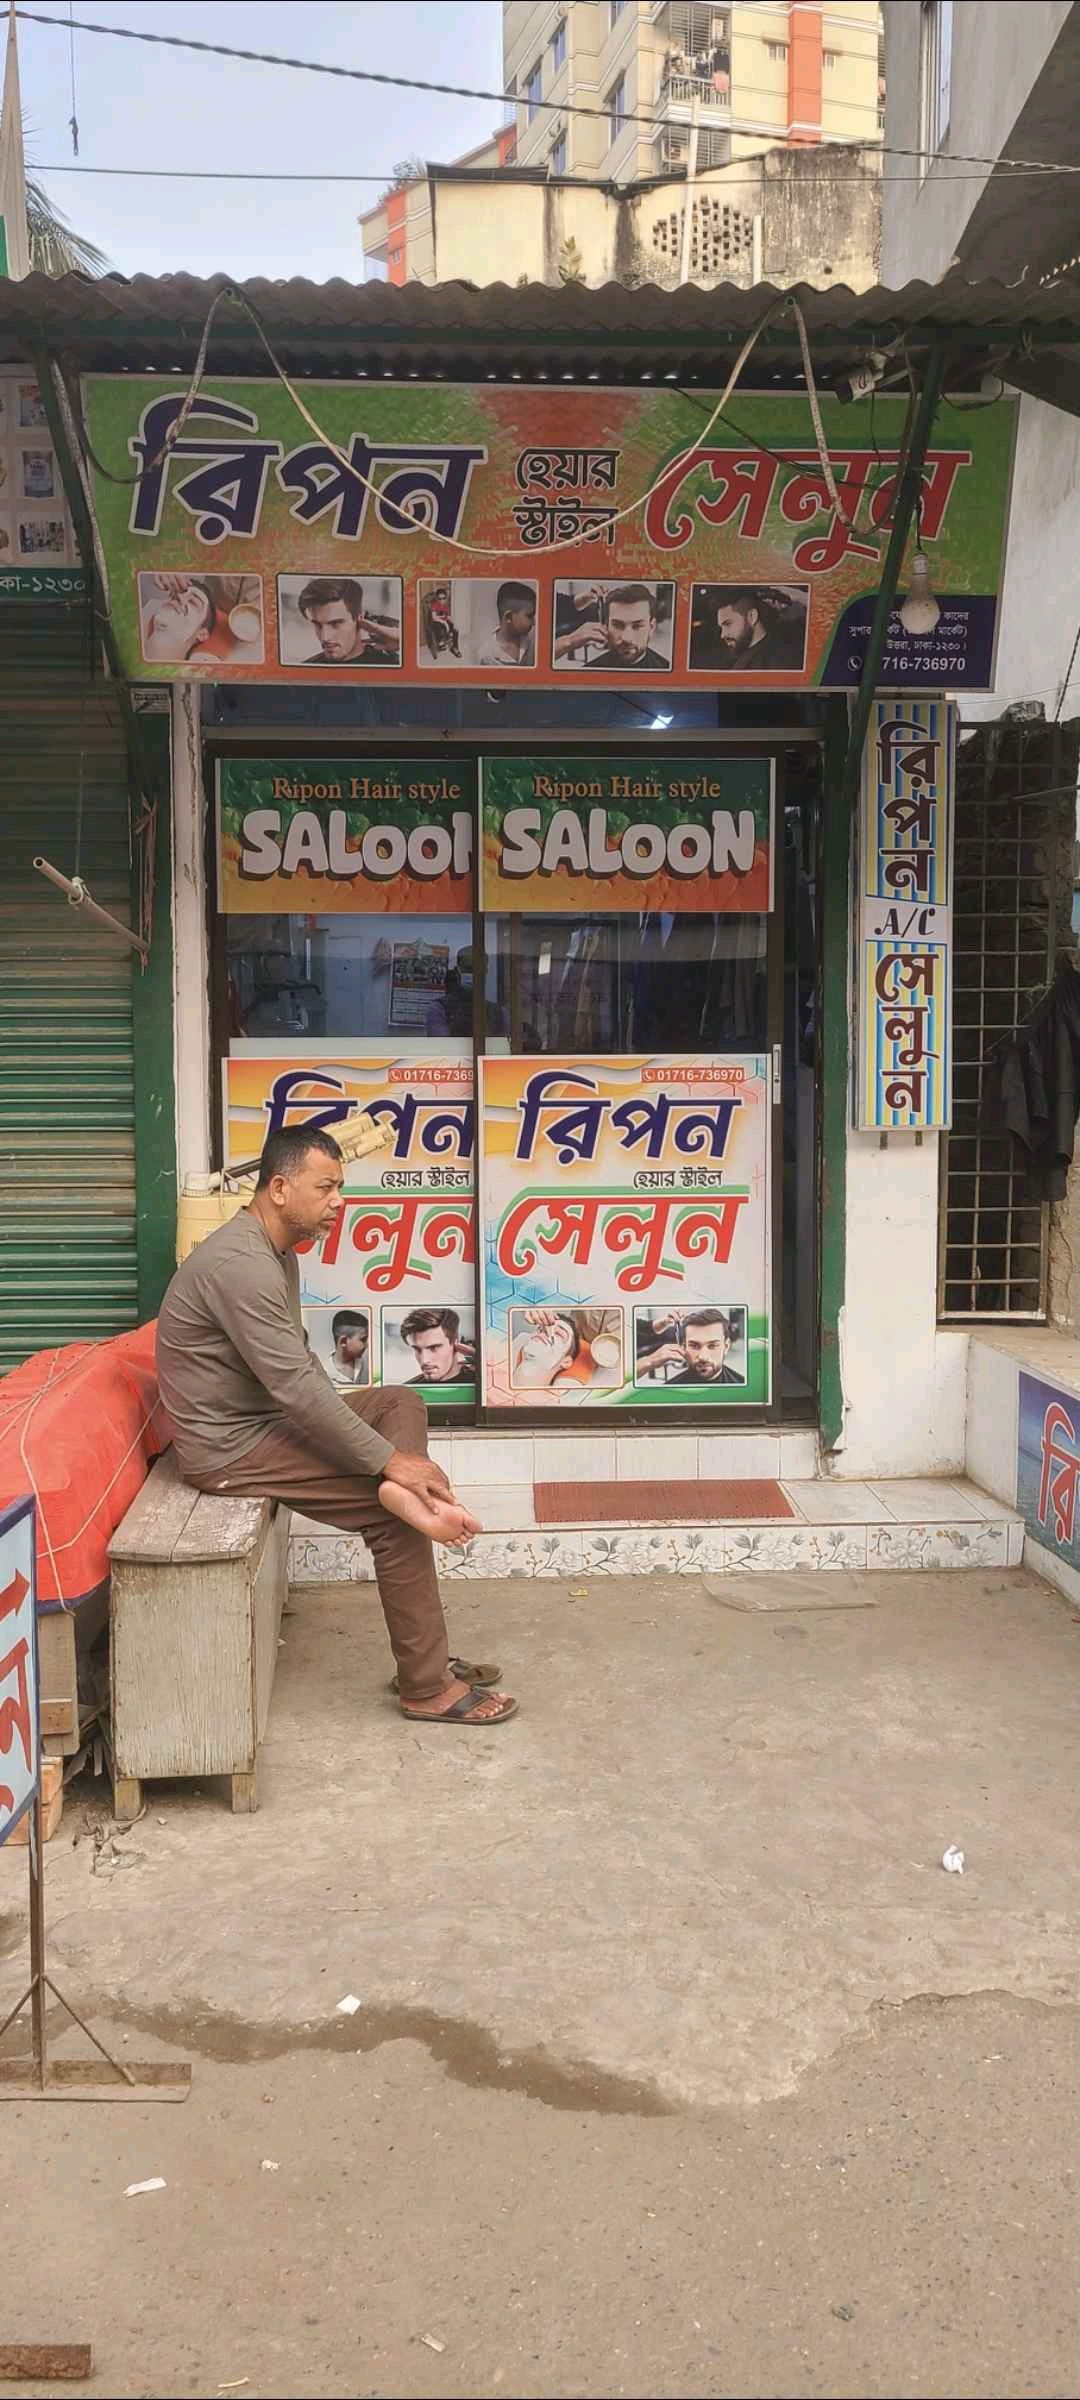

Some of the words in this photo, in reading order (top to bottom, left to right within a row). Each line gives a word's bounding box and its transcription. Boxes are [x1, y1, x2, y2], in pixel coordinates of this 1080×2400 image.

[128, 392, 488, 545] রিপন
[516, 447, 621, 490] হেয়ার
[512, 496, 621, 546] স্টাইল
[644, 447, 973, 574] সেলুন
[0, 575, 86, 594] কা-১২৩০
[881, 656, 967, 671] 716-736970
[272, 776, 342, 803] Ripon
[350, 777, 402, 800] Hair
[408, 779, 461, 803] style
[532, 774, 603, 801] Ripon
[609, 776, 661, 798] Hair
[668, 777, 721, 801] style
[875, 718, 941, 894] রিপন
[874, 906, 936, 940] A/C
[874, 951, 941, 1114] সেলুন
[403, 1068, 473, 1082] 01716-7369
[657, 1068, 743, 1081] 01716-736970
[515, 1069, 743, 1165] রিপন
[381, 1169, 423, 1188] হেয়ার
[426, 1167, 470, 1188] স্টাইল
[633, 1168, 676, 1188] হেয়ার
[679, 1166, 722, 1187] স্টাইল
[497, 1193, 750, 1293] সেলুন
